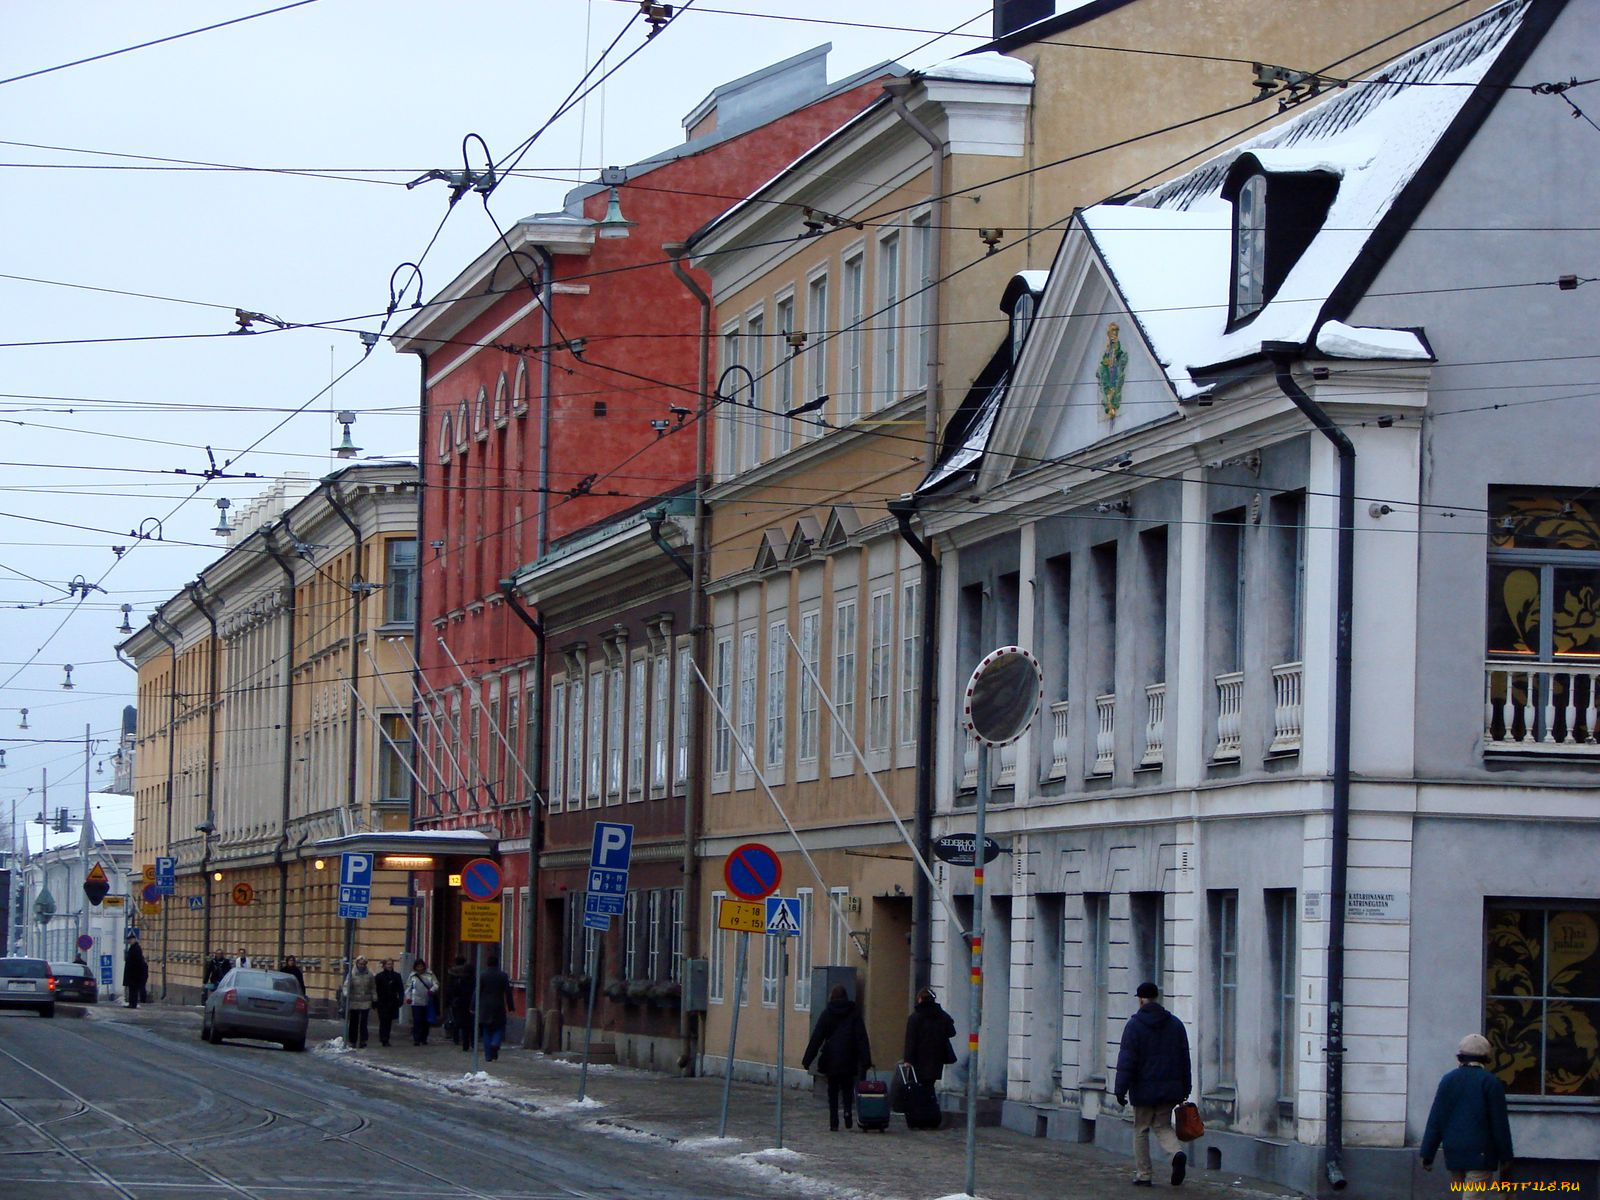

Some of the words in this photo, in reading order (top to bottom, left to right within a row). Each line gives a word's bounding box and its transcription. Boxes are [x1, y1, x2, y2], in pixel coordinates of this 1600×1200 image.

[599, 826, 626, 865] P
[160, 859, 172, 875] P
[347, 856, 369, 883] P
[1348, 893, 1395, 901] KATARIINANKATU
[848, 903, 857, 911] 18
[1348, 900, 1389, 908] KATRINEGATAN
[737, 906, 741, 914] 7
[752, 907, 760, 916] 18
[731, 917, 740, 925] (9
[752, 919, 763, 928] 15)
